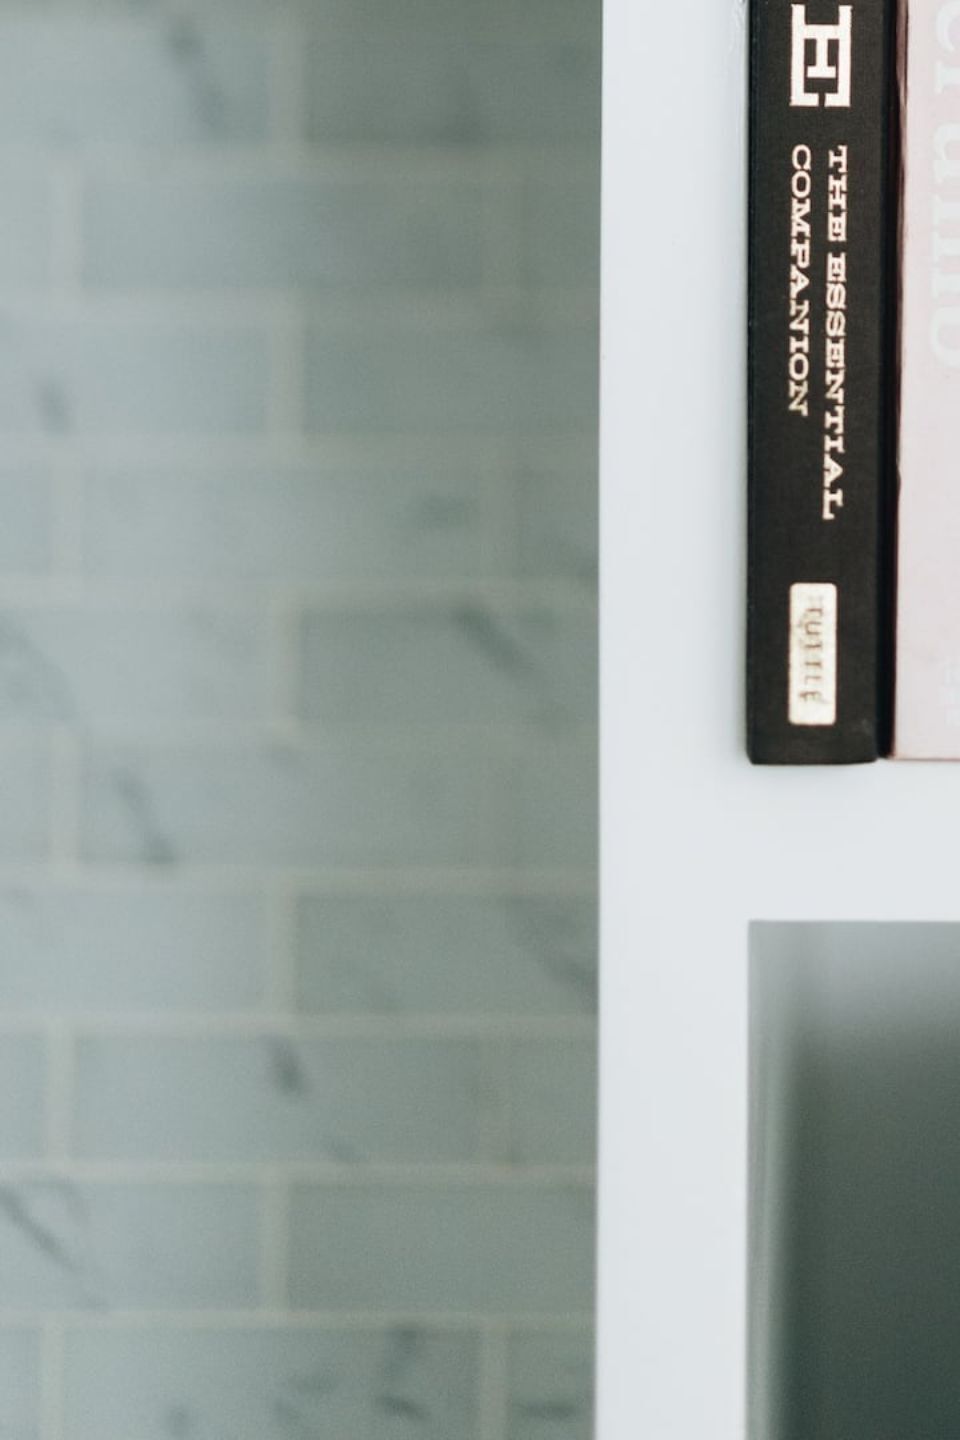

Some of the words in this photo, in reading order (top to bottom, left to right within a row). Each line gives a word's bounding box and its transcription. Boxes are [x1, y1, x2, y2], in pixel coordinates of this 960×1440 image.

[787, 144, 812, 417] COMPANION
[826, 144, 849, 242] THE
[821, 251, 848, 521] ESSENTIAL
